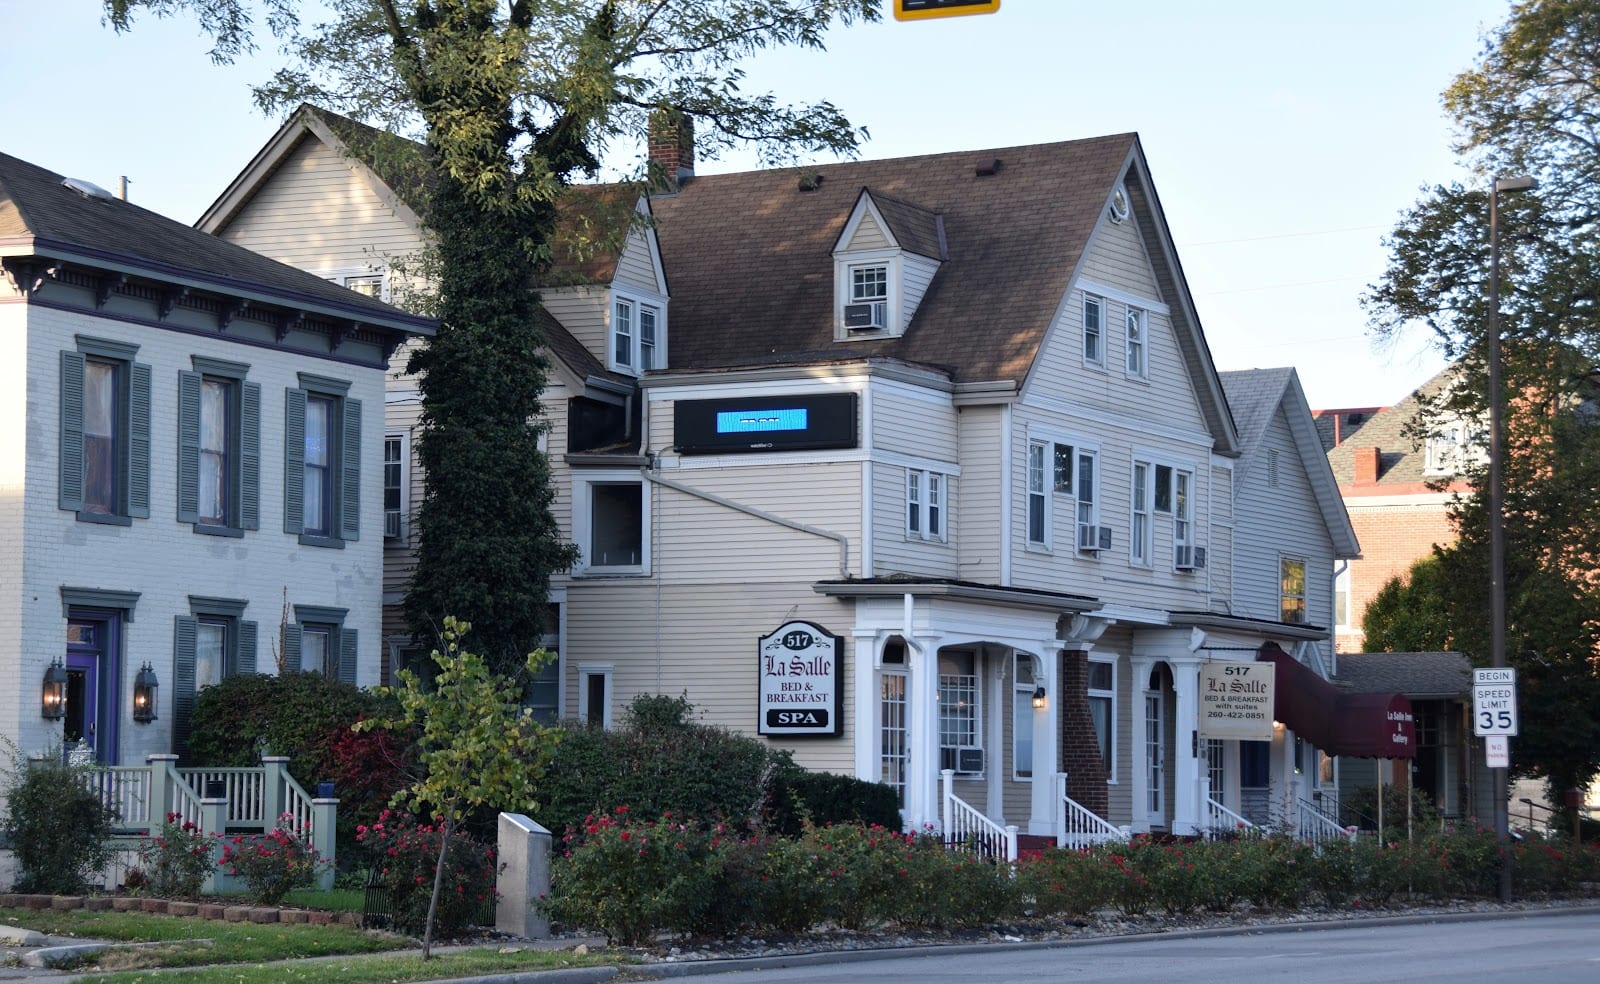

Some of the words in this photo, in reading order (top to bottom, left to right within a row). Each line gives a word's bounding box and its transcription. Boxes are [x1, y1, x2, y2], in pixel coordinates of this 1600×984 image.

[788, 634, 808, 647] 517
[764, 655, 785, 676] La
[788, 656, 831, 677] Salle
[1225, 667, 1250, 676] 517
[1480, 672, 1509, 680] BEGIN
[781, 682, 802, 692] BED
[804, 682, 814, 691] &
[1208, 678, 1226, 692] La
[1230, 679, 1267, 693] Salle
[767, 694, 828, 702] BREAKFAST
[1478, 690, 1511, 698] SPEED
[778, 712, 818, 724] SPA
[1480, 711, 1512, 729] 35
